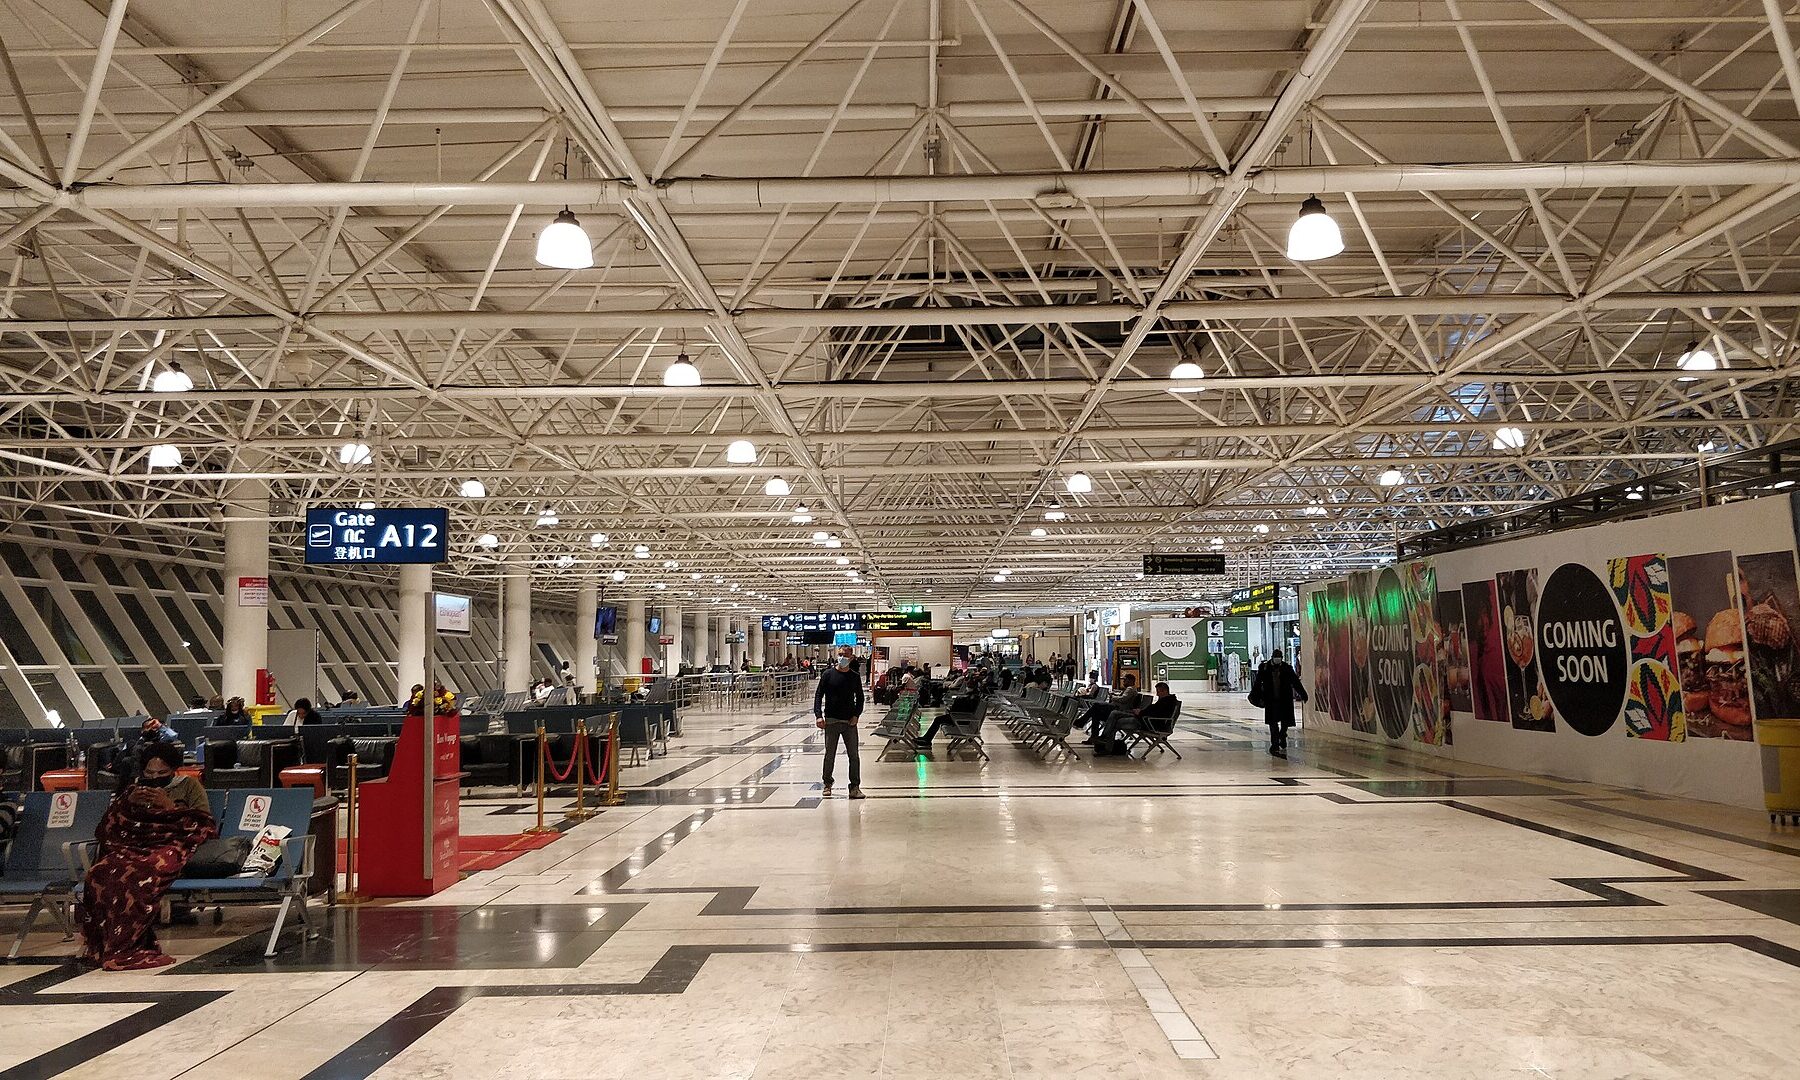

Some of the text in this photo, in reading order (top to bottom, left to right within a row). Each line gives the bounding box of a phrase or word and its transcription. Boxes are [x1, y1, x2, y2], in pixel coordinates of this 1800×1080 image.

[335, 511, 376, 526] Gate
[380, 524, 438, 548] A12
[334, 546, 376, 560] 登机口
[1372, 623, 1409, 652] COMING
[1543, 619, 1617, 649] COMING
[1378, 658, 1406, 687] SOON
[1556, 655, 1609, 683] SOON
